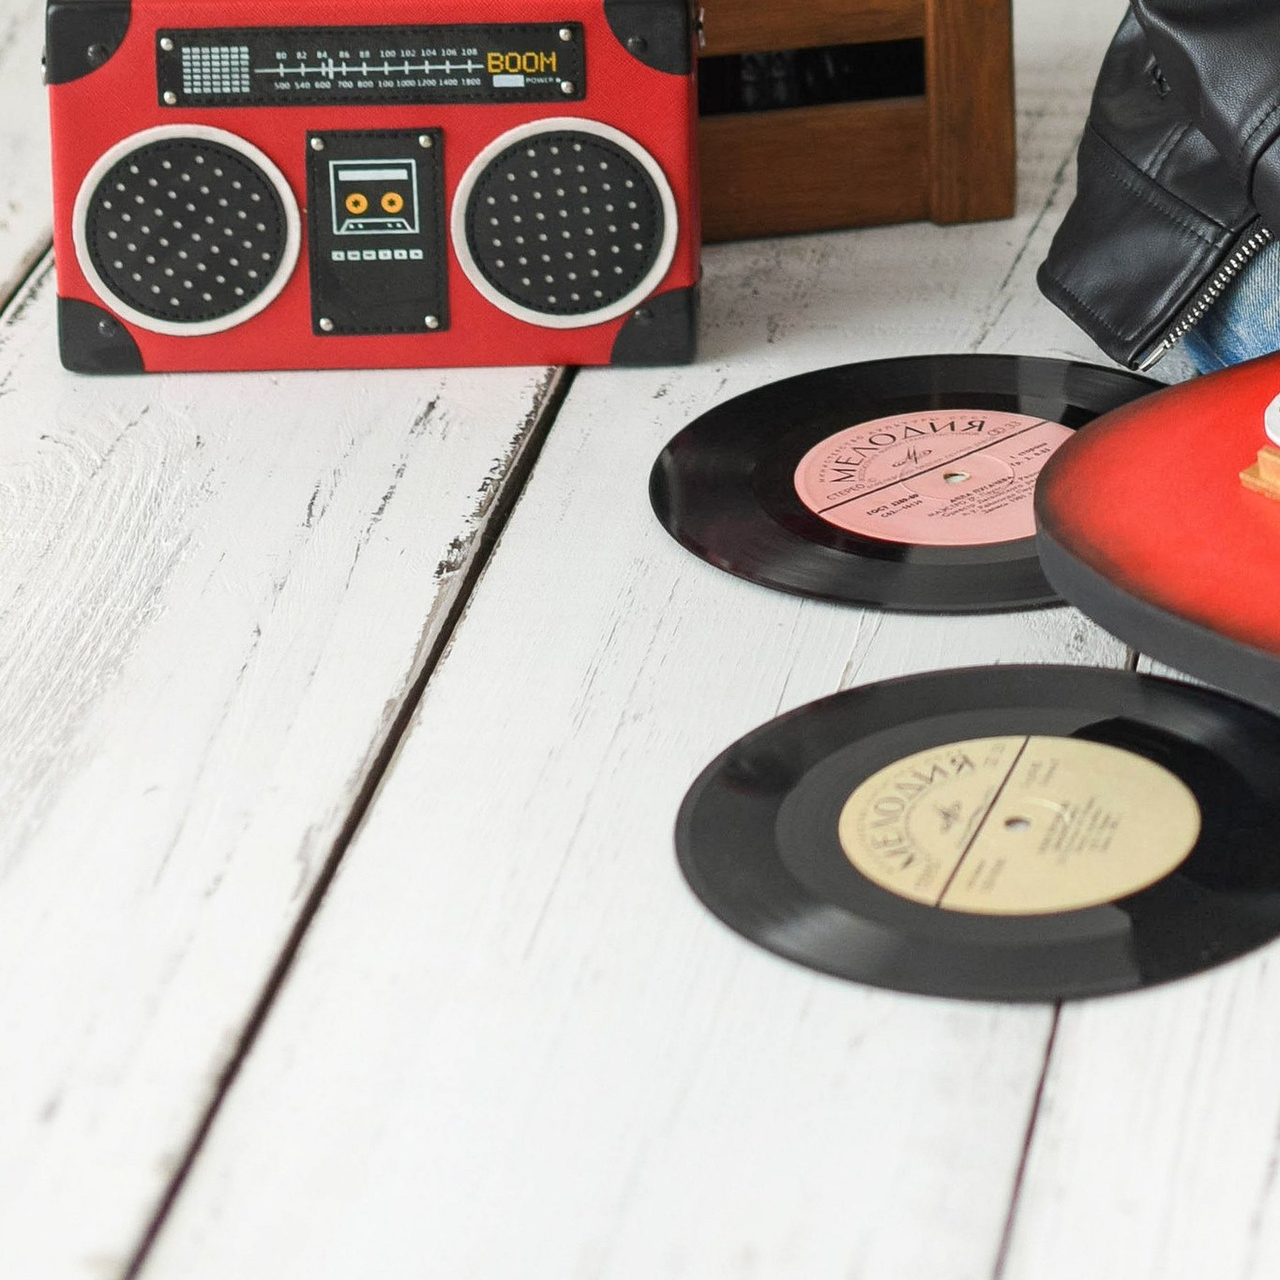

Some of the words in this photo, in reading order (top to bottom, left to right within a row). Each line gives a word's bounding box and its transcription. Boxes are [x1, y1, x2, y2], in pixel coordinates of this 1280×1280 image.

[380, 49, 397, 58] 100
[400, 49, 416, 58] 102
[421, 48, 437, 57] 104
[441, 48, 458, 57] 106
[461, 48, 478, 56] 108
[486, 51, 557, 73] BOOM
[337, 80, 353, 89] 700
[417, 78, 437, 87] 1200
[830, 420, 986, 483] МЕЛОДИЯ
